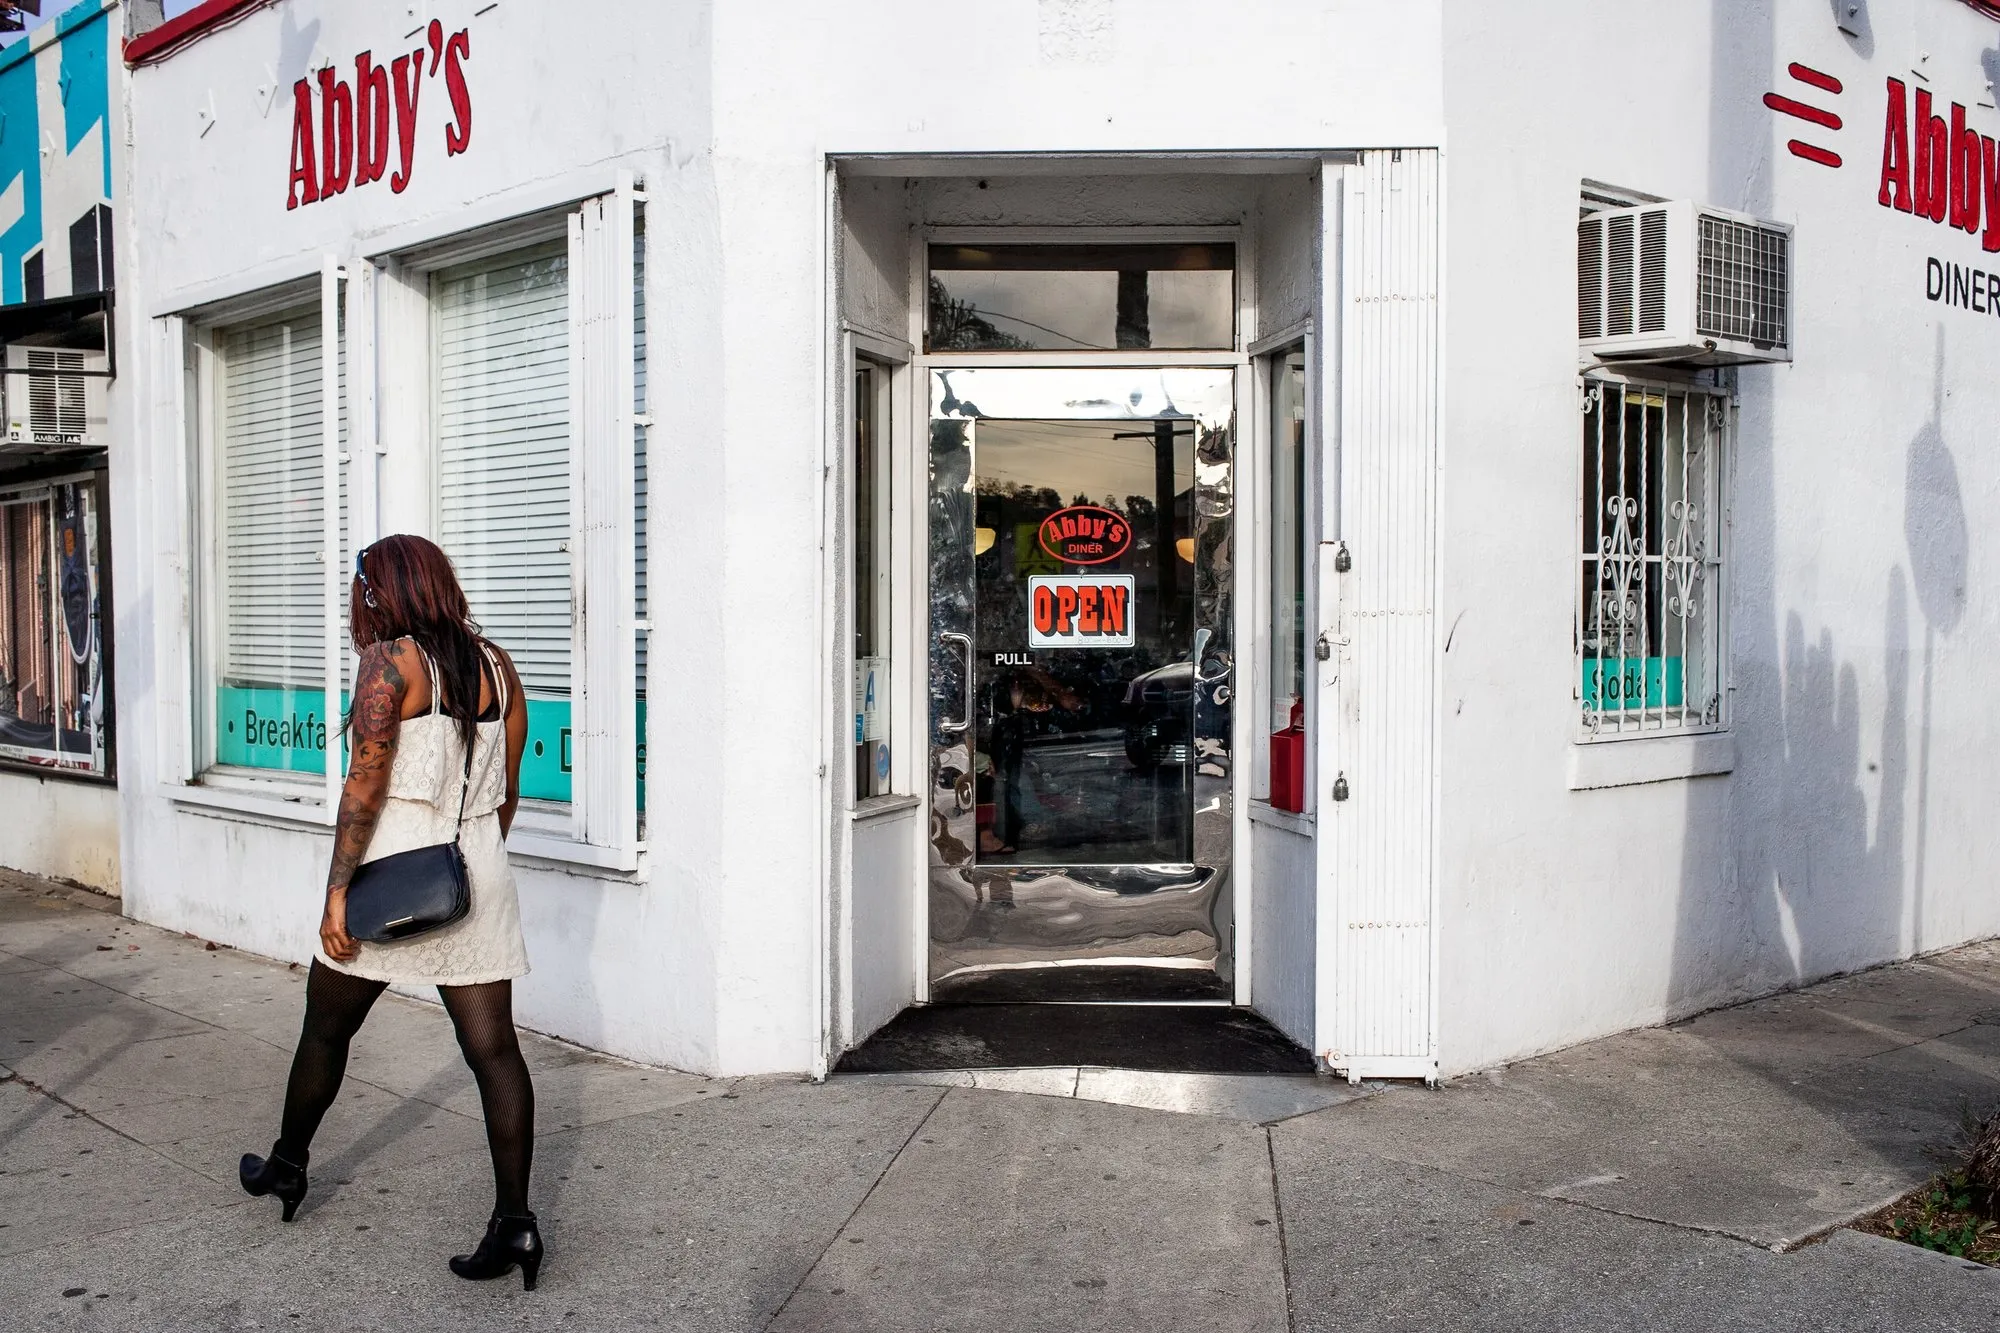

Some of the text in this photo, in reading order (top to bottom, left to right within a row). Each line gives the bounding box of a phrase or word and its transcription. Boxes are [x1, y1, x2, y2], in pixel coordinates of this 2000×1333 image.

[286, 18, 472, 211] Abby's
[1926, 256, 2000, 318] DINER
[1047, 514, 1125, 543] Abby's
[1068, 543, 1103, 554] DINER
[1033, 585, 1129, 636] OPEN
[995, 653, 1032, 665] PULL
[1591, 667, 1648, 701] Soda
[245, 709, 349, 753] Breakfa
